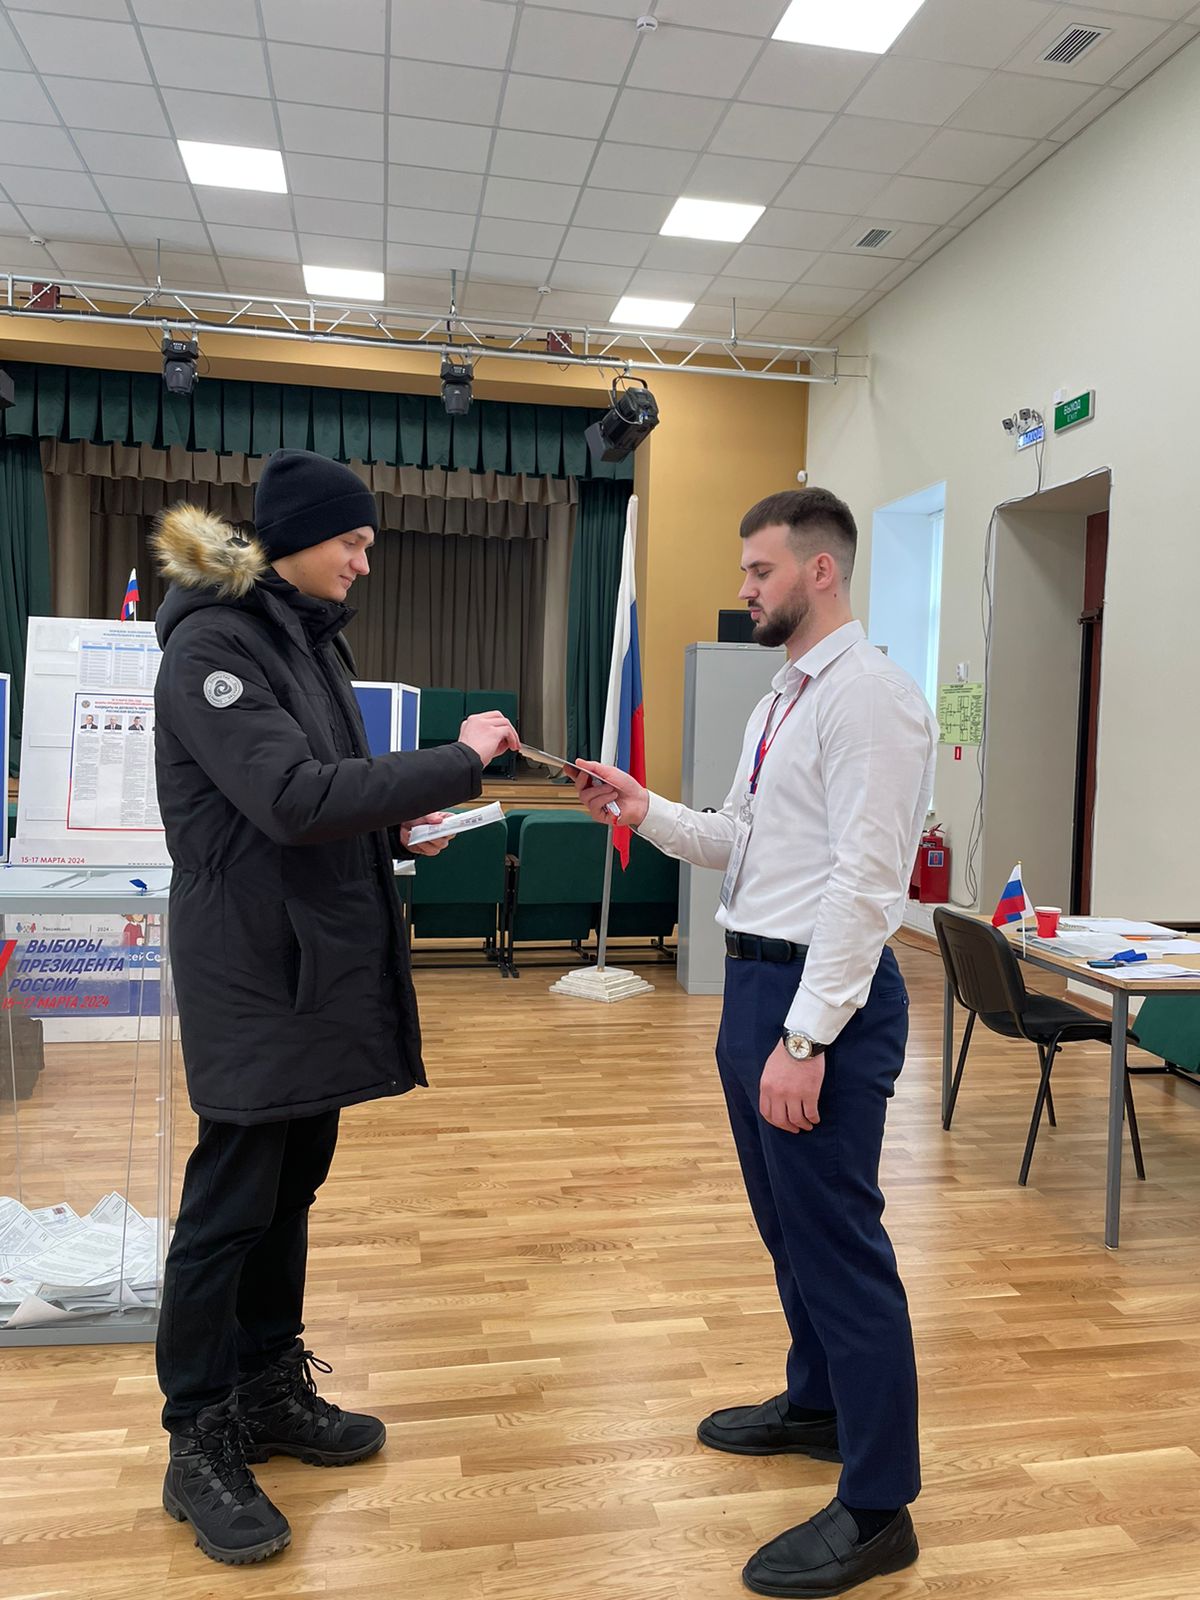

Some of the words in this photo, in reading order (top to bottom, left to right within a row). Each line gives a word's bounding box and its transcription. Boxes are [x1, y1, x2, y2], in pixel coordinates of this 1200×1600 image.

[21, 856, 39, 864] 15-17
[26, 939, 103, 954] ВЫБОРЫ
[17, 958, 125, 974] ПРЕЗИДЕНТА
[8, 977, 79, 993] РОССИИ
[36, 995, 79, 1009] МАРТА
[80, 994, 110, 1009] 2024
